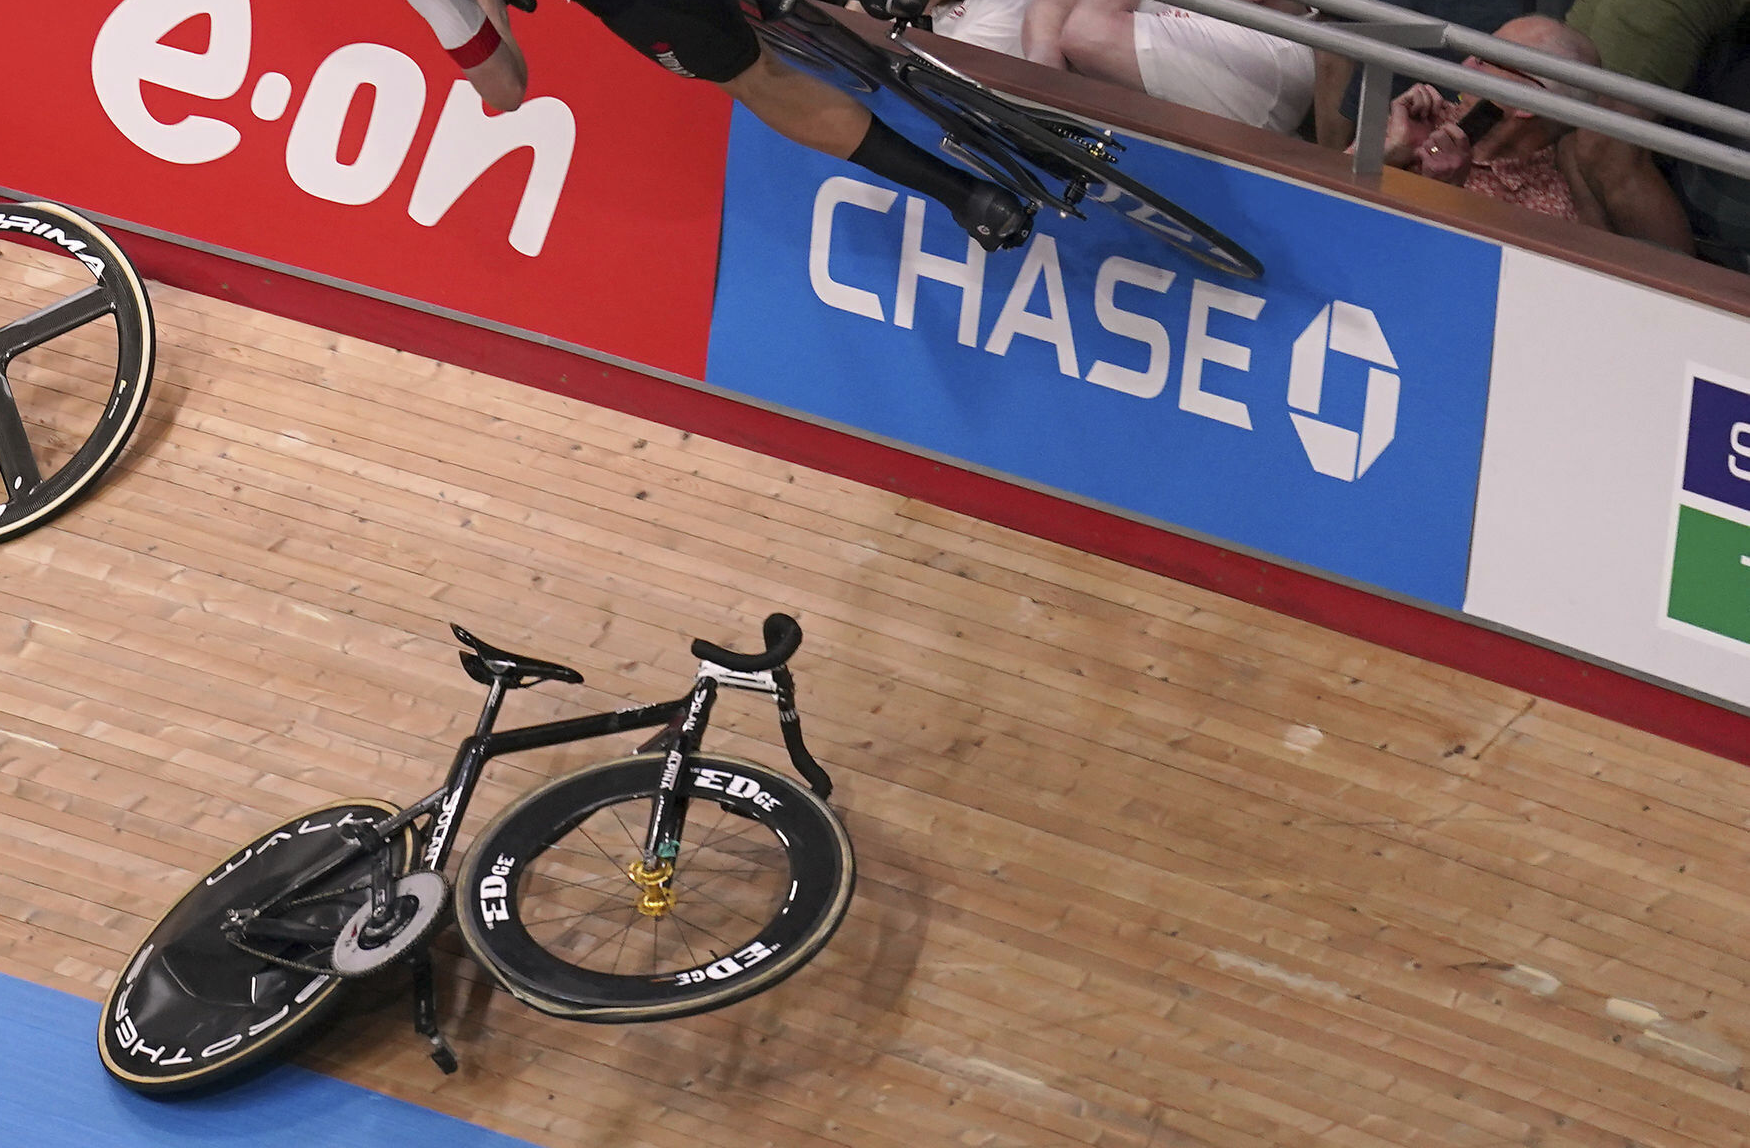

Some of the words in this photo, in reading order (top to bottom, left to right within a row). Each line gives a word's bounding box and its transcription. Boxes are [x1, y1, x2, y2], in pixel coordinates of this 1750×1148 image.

[808, 175, 1267, 431] CHASE
[659, 749, 683, 792] ALPINA
[693, 766, 784, 813] EDGE
[478, 853, 516, 931] EDGE
[673, 939, 782, 988] EDGE
[113, 944, 331, 1066] BROTHERS
